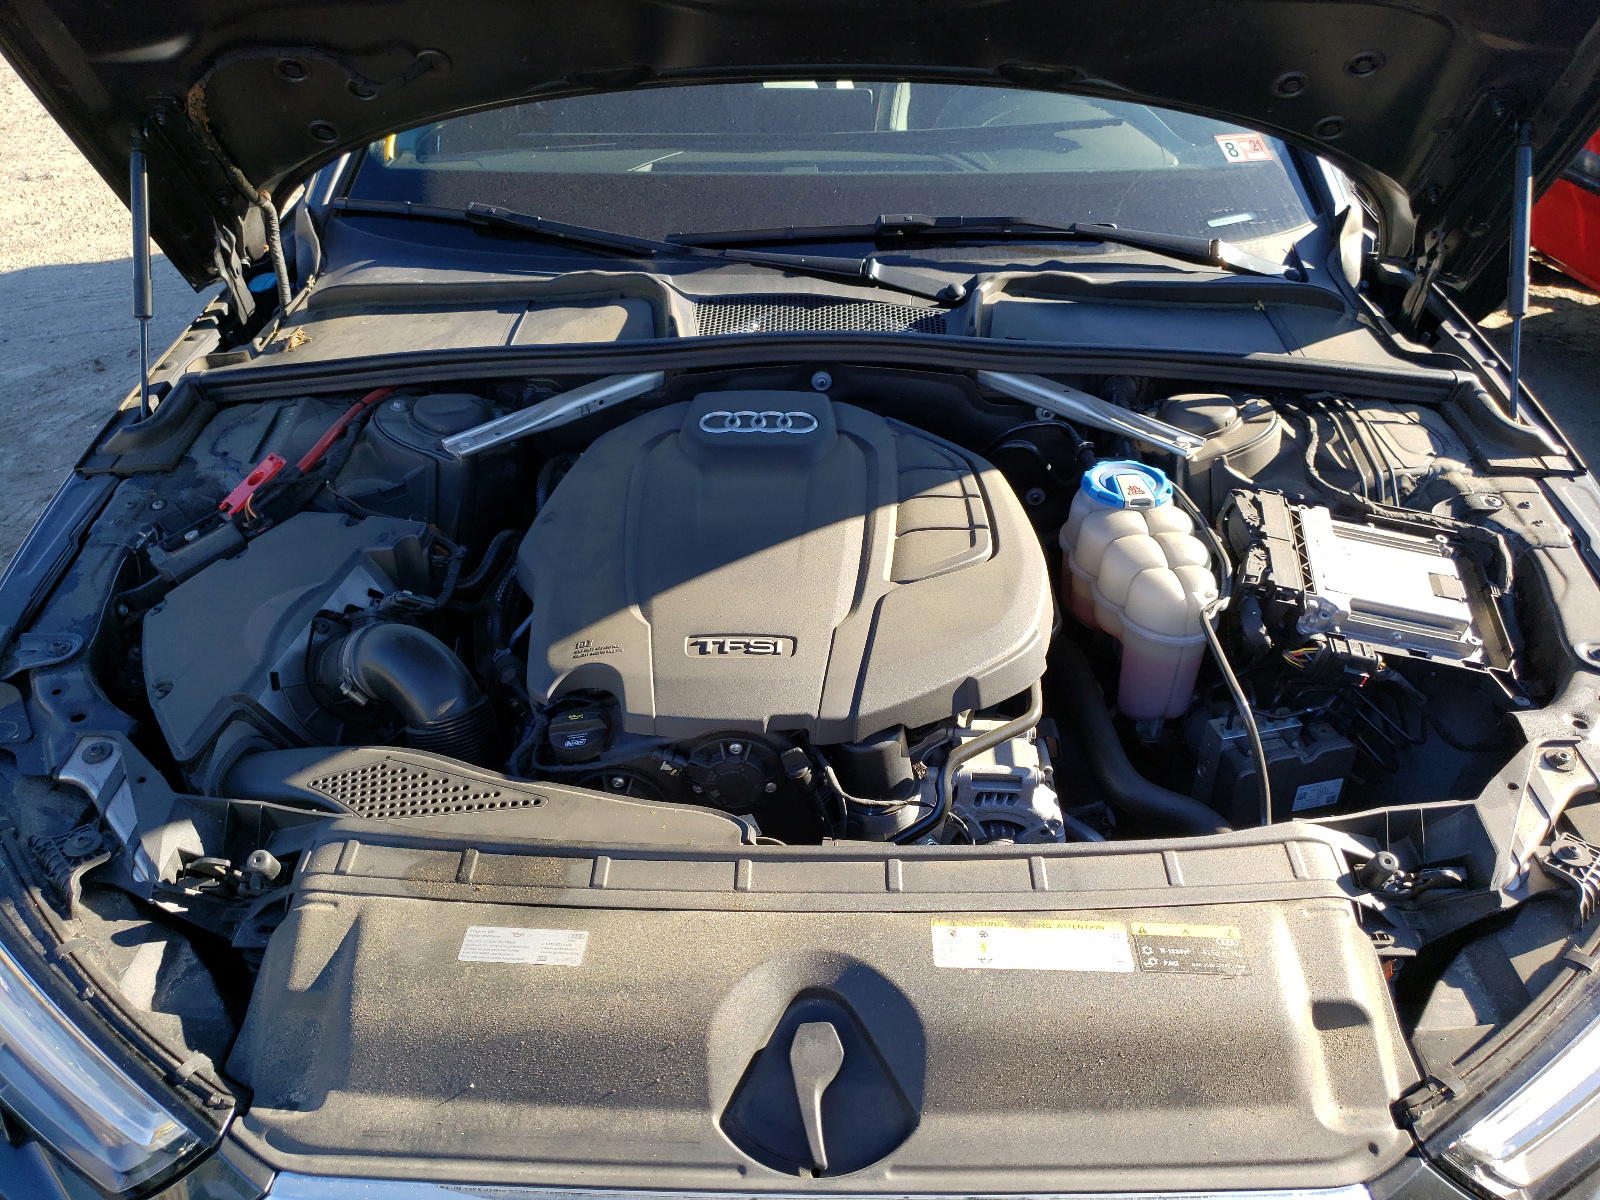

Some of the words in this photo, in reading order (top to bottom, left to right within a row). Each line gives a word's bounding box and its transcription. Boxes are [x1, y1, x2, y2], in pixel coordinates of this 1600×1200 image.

[1224, 141, 1239, 157] 8
[1249, 139, 1264, 151] 21
[690, 638, 783, 656] TFSI
